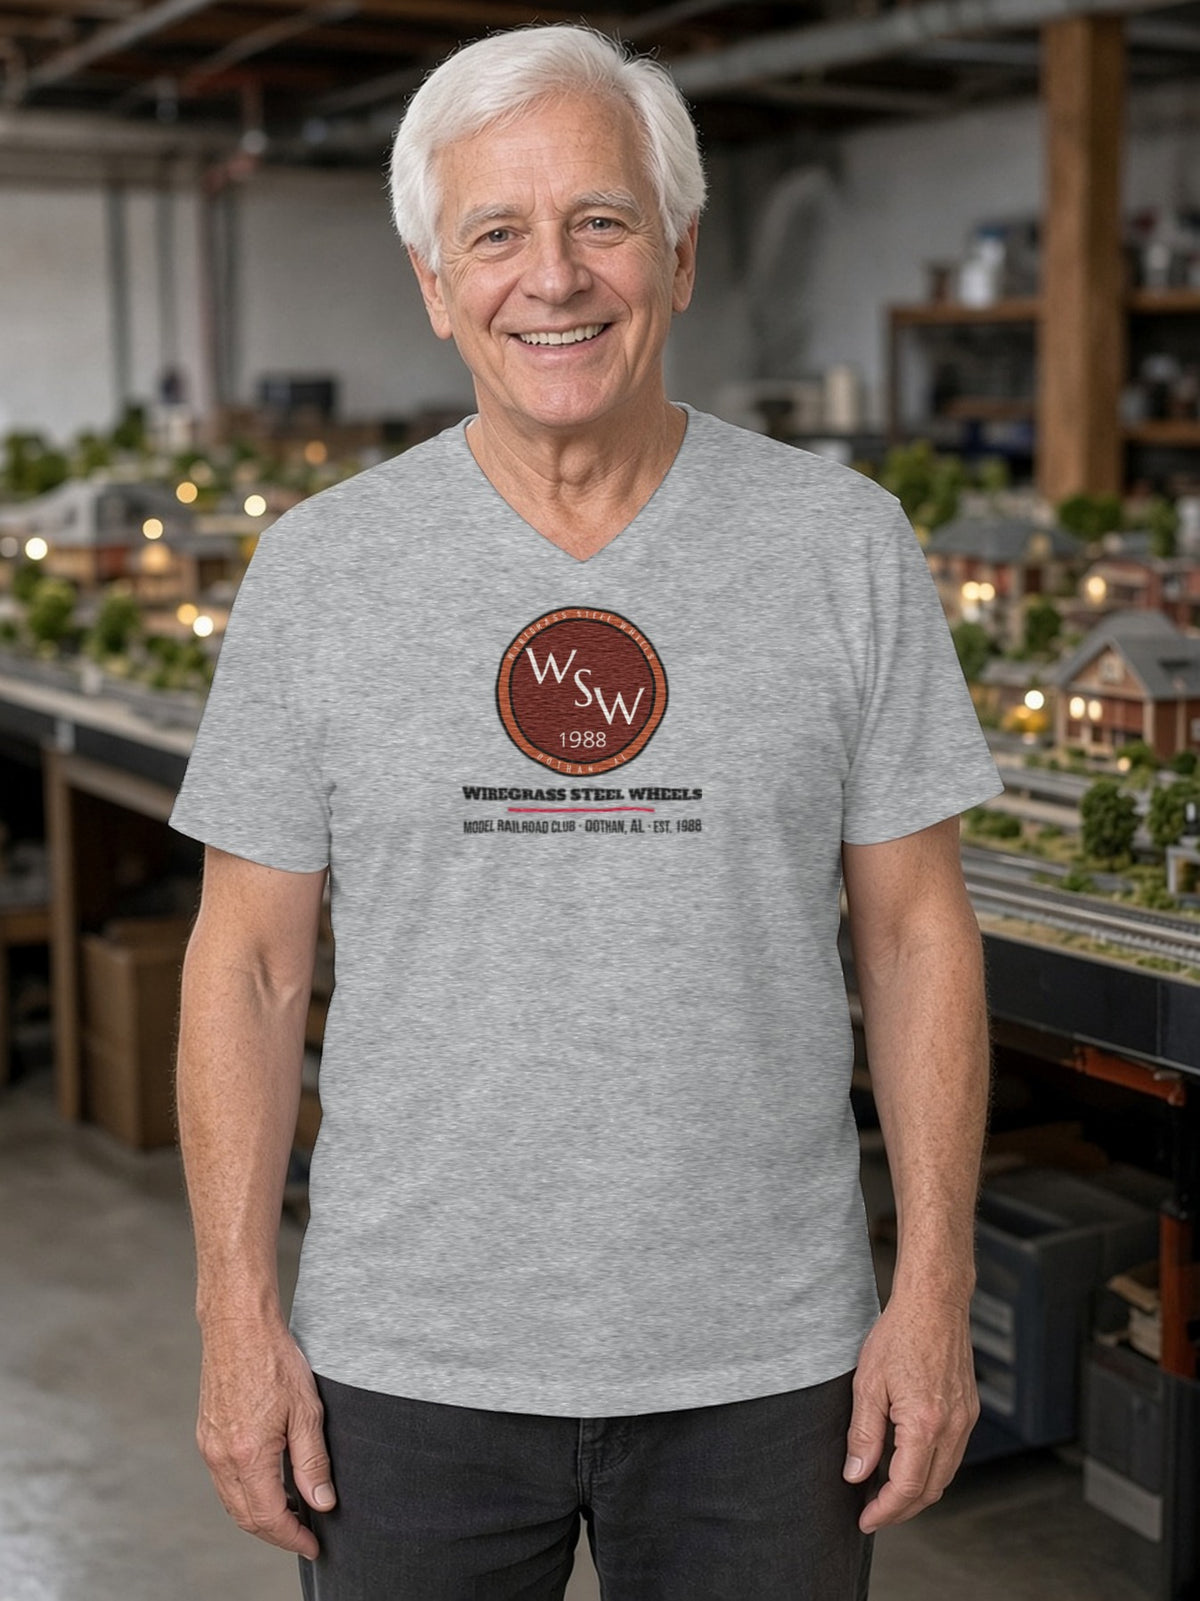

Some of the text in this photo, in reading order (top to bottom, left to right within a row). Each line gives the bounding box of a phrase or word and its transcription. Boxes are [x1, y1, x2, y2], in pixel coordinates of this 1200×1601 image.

[559, 731, 607, 749] 1988
[462, 786, 703, 801] WIREGRASS STEEL WHEELS
[463, 819, 702, 835] MODEL RAILROAD CLUB DOTHAN, AL EST. 1988
